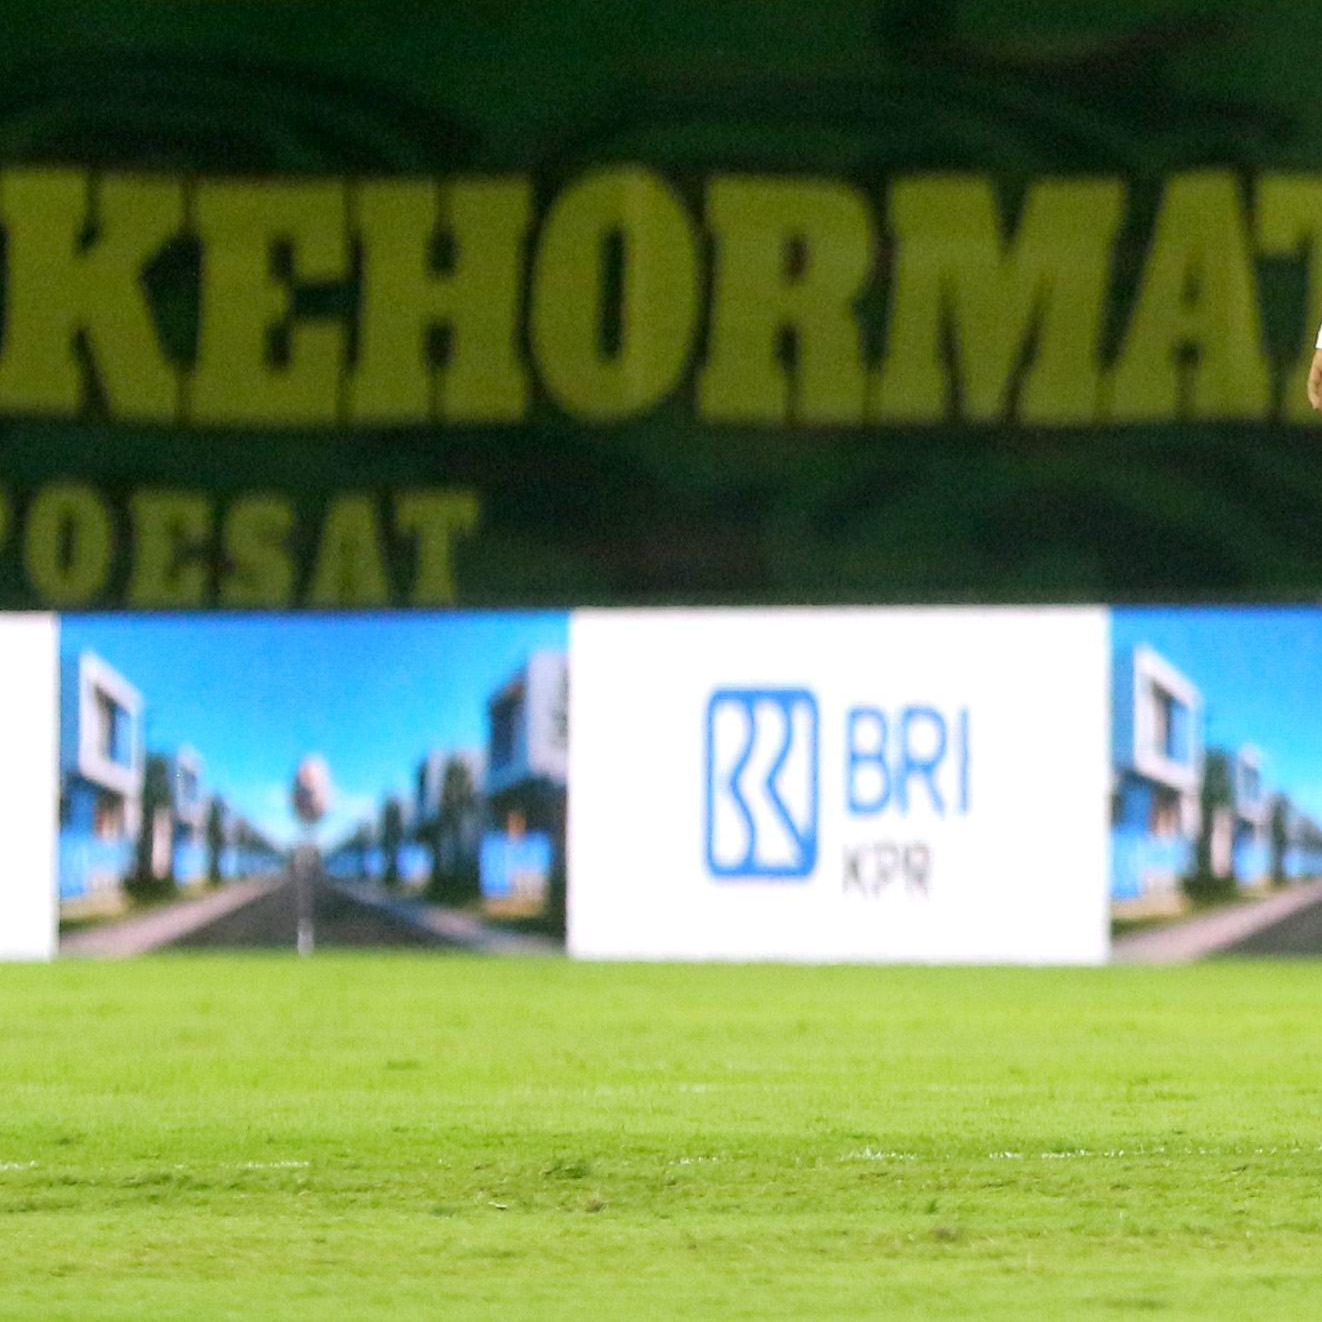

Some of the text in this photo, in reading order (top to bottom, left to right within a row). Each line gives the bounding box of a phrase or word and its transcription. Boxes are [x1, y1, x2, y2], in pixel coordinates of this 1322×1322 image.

[0, 484, 479, 609] OESAT
[845, 703, 970, 818] BRI
[842, 841, 930, 900] KPR
